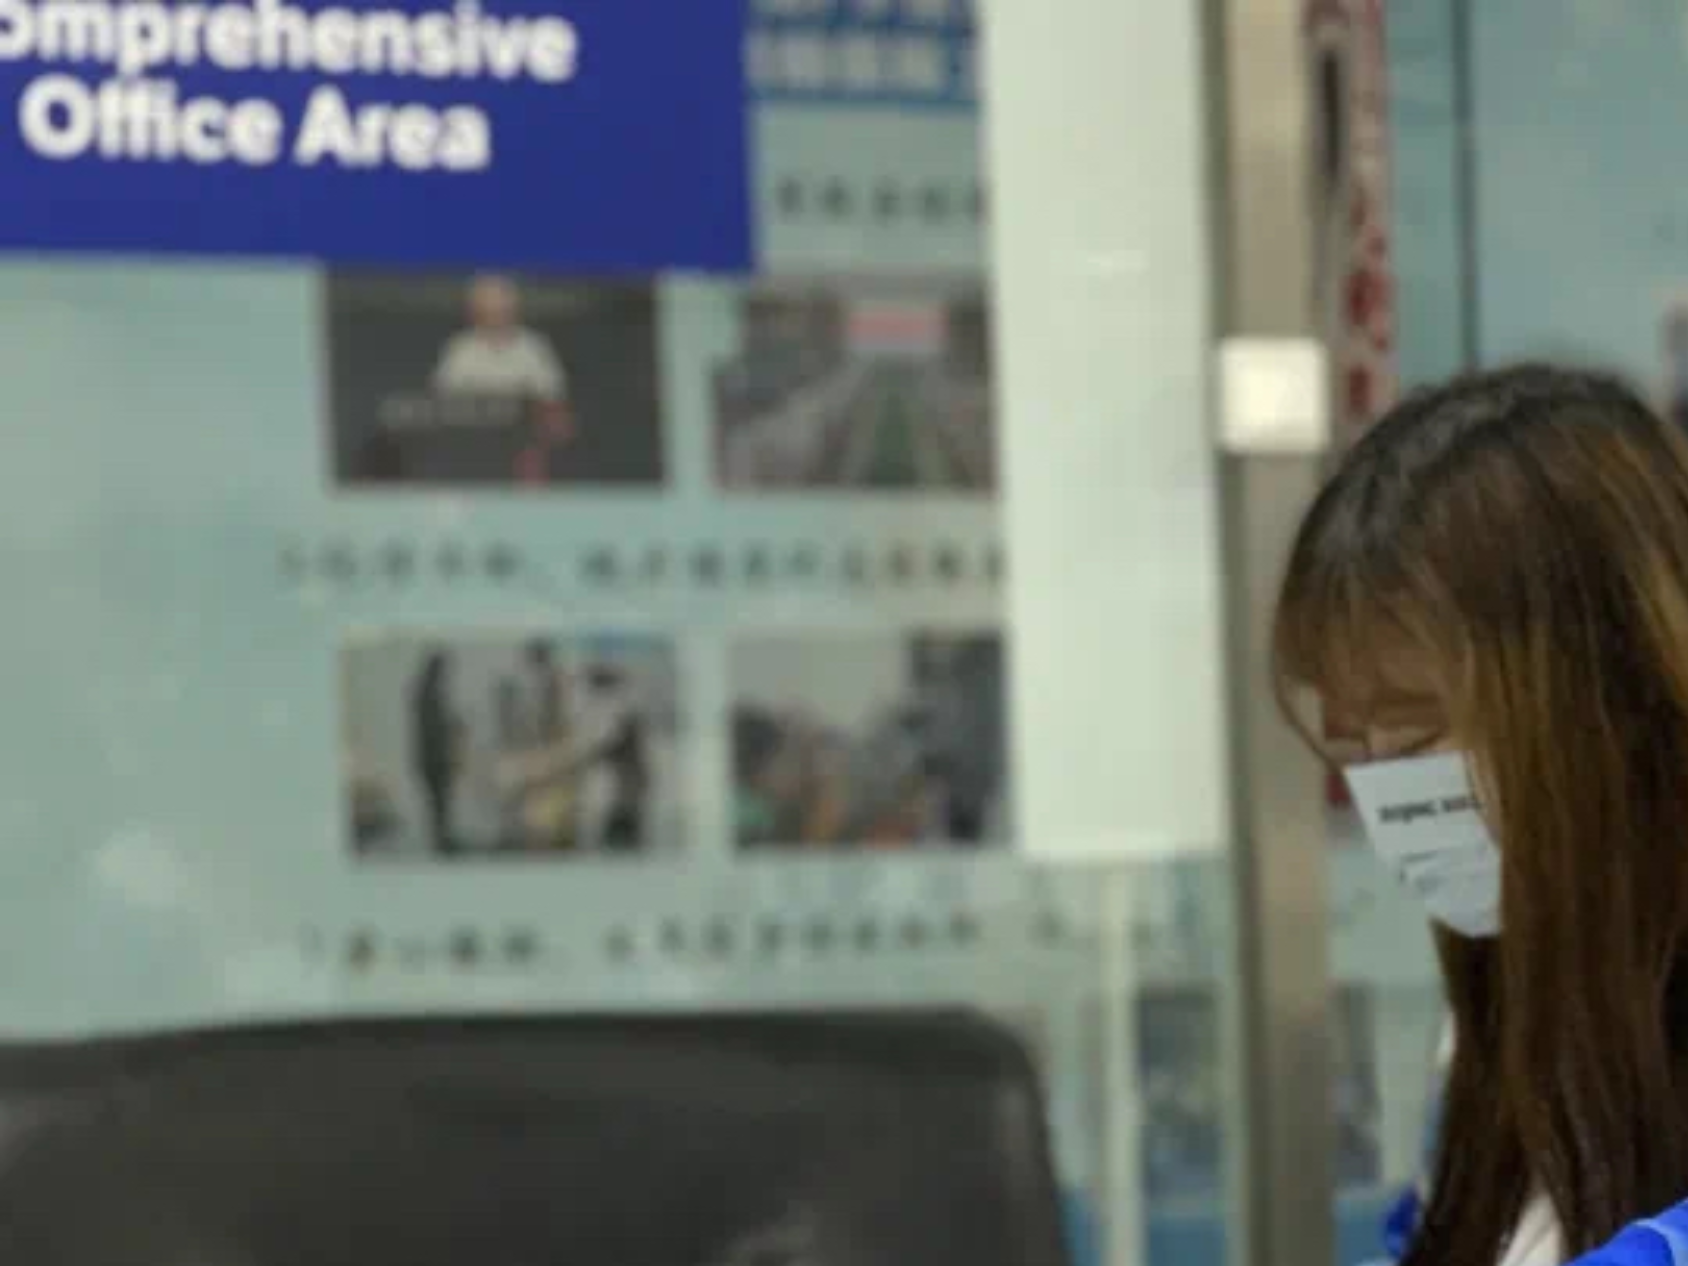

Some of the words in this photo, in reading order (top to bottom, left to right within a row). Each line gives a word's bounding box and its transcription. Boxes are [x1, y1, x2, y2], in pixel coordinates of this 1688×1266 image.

[0, 0, 579, 83] omprehensive
[18, 72, 283, 166] Office
[293, 84, 493, 171] Area
